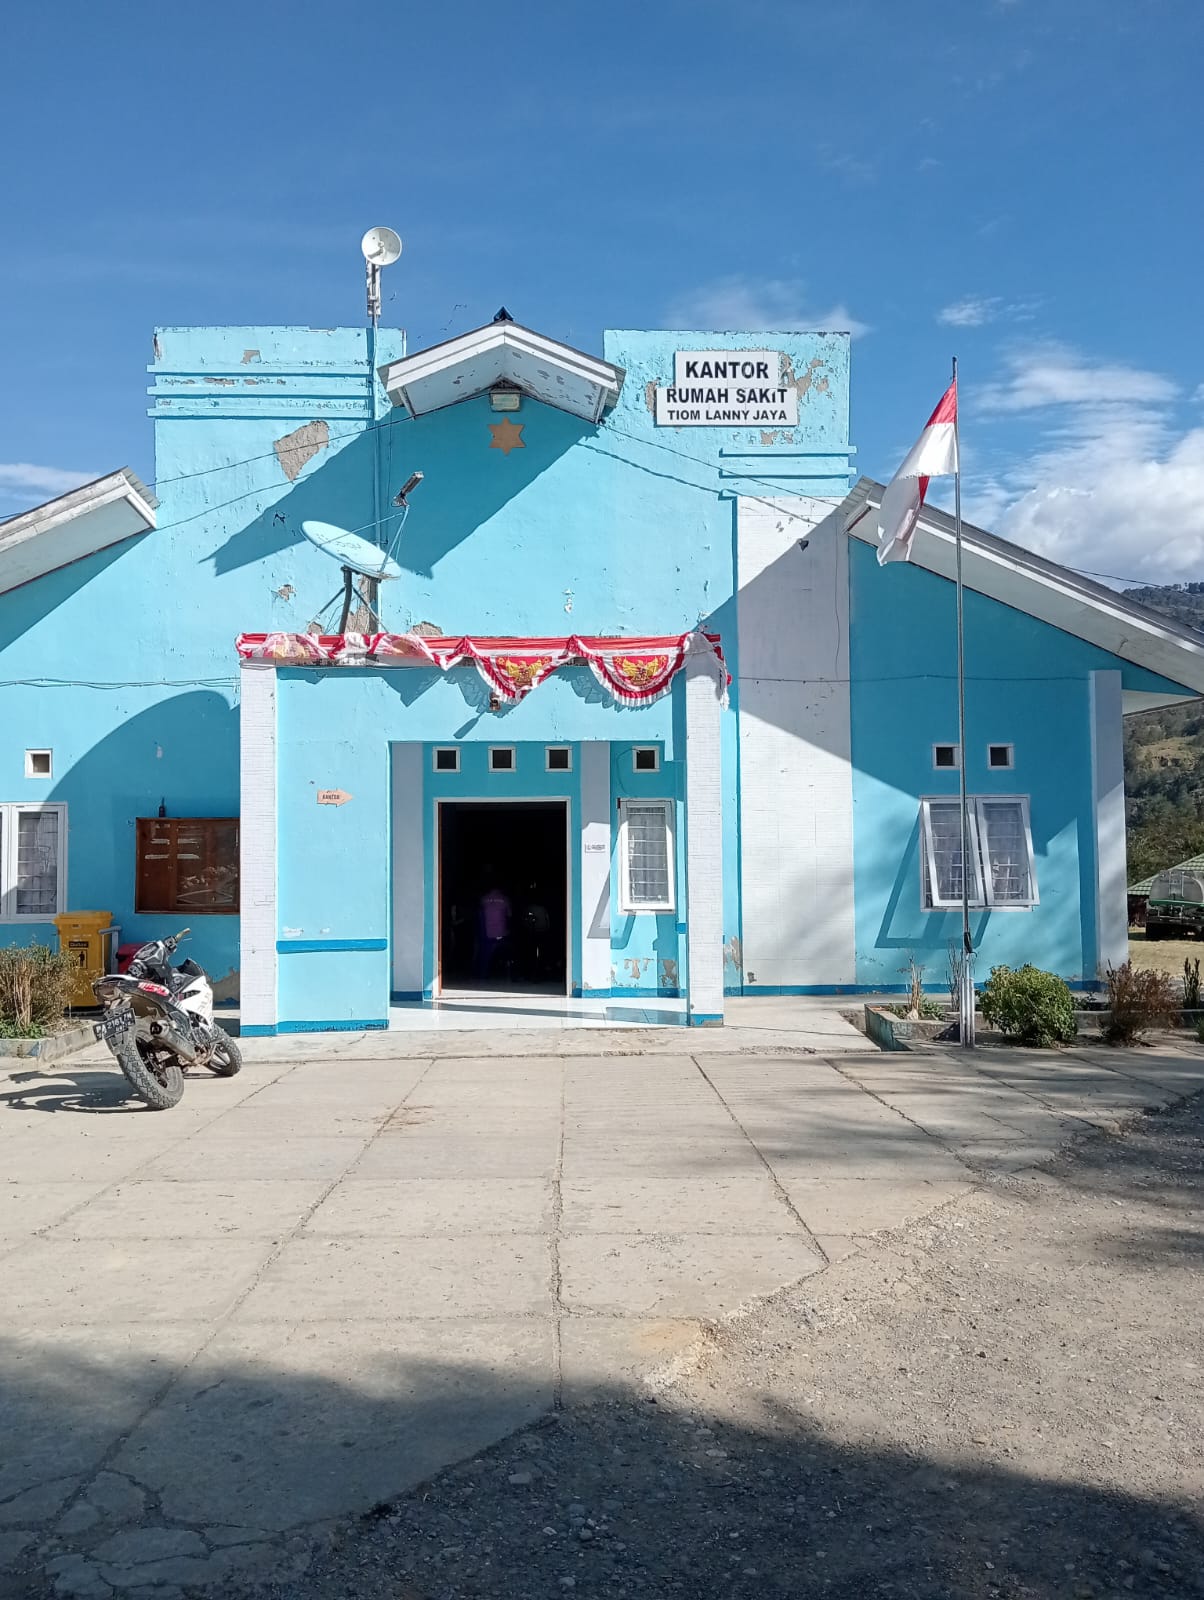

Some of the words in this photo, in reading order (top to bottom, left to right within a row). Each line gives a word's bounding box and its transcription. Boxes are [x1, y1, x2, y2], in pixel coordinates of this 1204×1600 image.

[685, 361, 769, 379] KANTOR
[666, 388, 729, 403] RUMAH
[736, 388, 788, 403] SAKIT
[667, 410, 700, 421] TIOM
[706, 410, 750, 421] LANNY
[753, 410, 787, 421] JAYA
